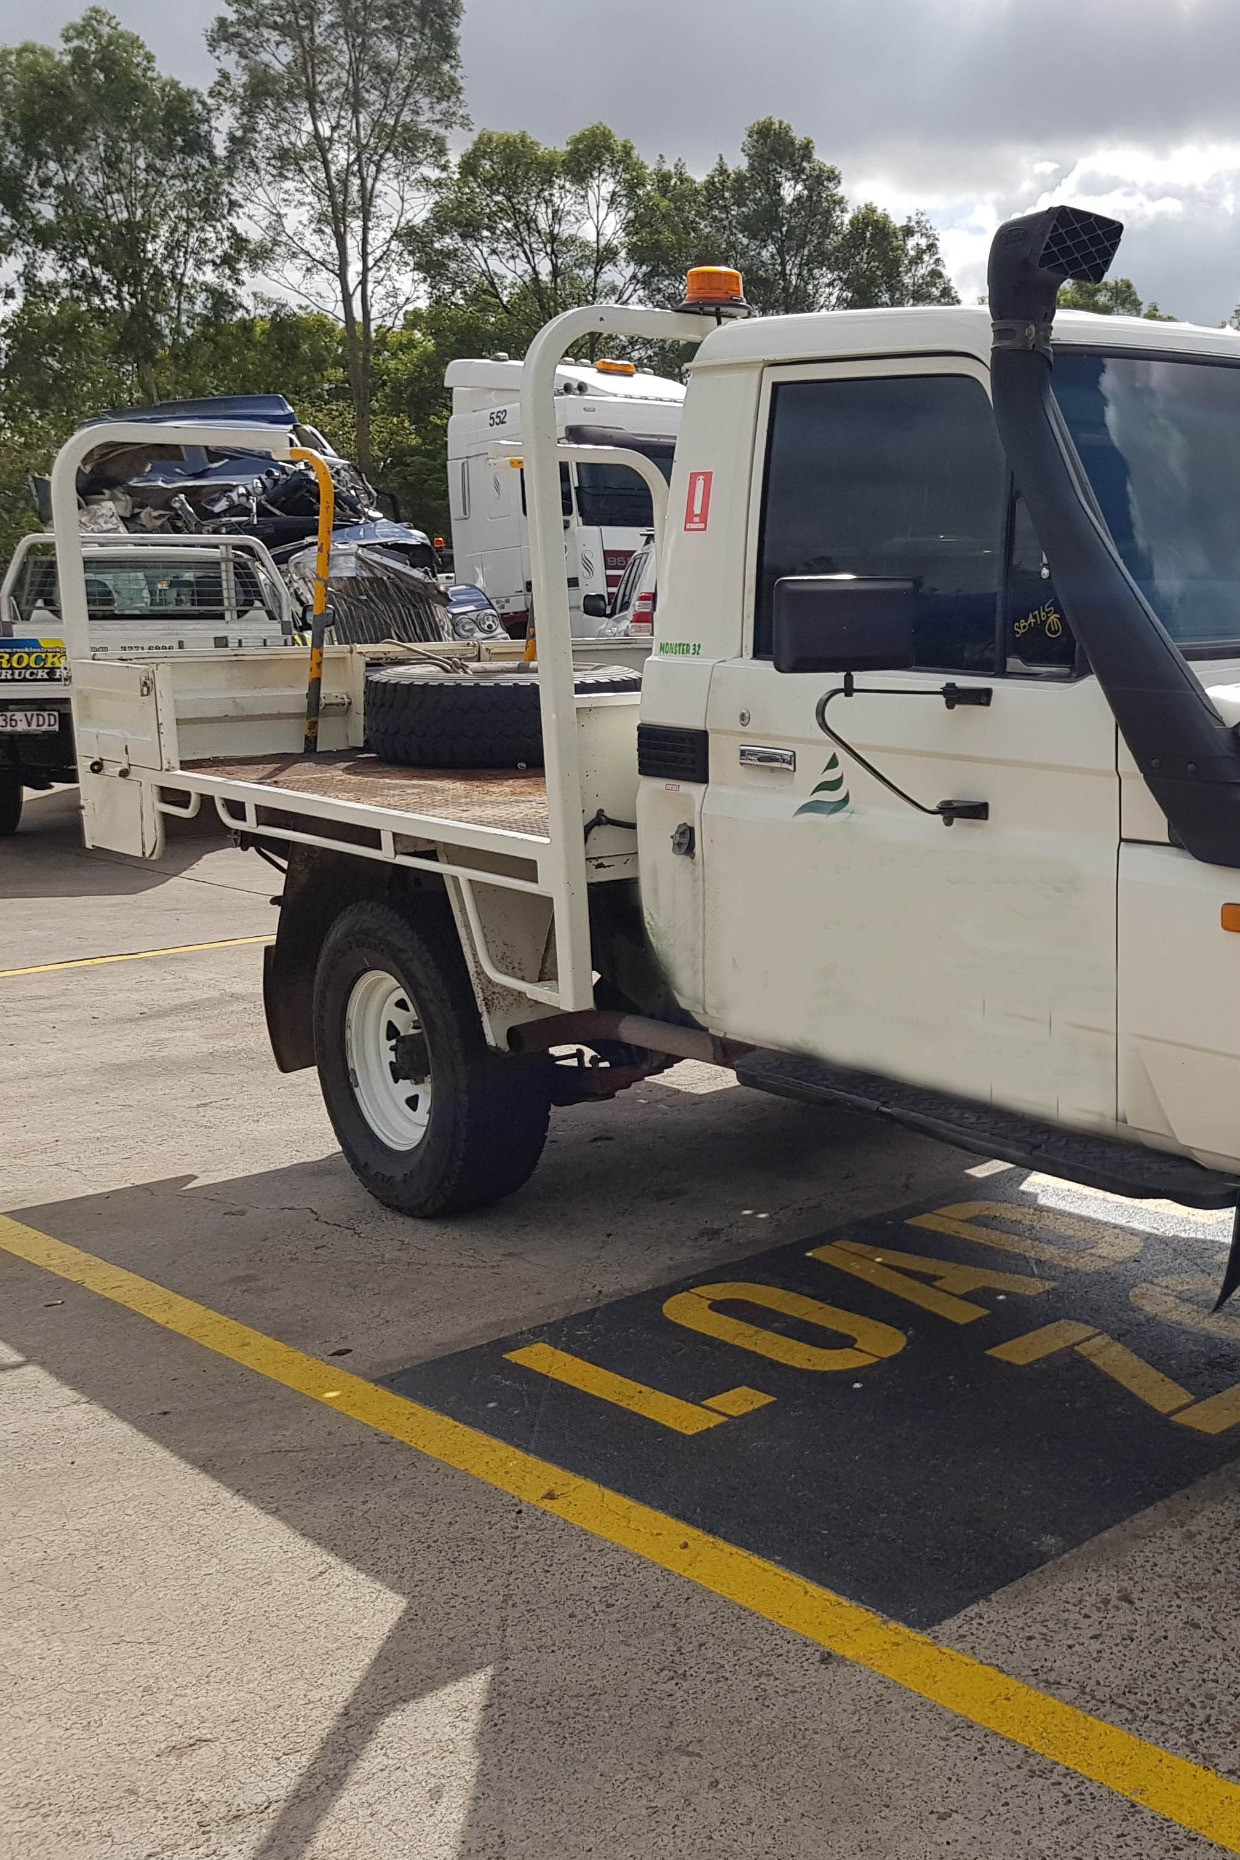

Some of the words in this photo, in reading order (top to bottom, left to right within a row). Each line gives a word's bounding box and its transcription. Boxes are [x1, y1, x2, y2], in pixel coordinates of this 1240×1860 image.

[489, 409, 507, 427] 552
[659, 641, 691, 655] MONSTER
[692, 643, 702, 655] 32
[0, 669, 50, 679] RUCK
